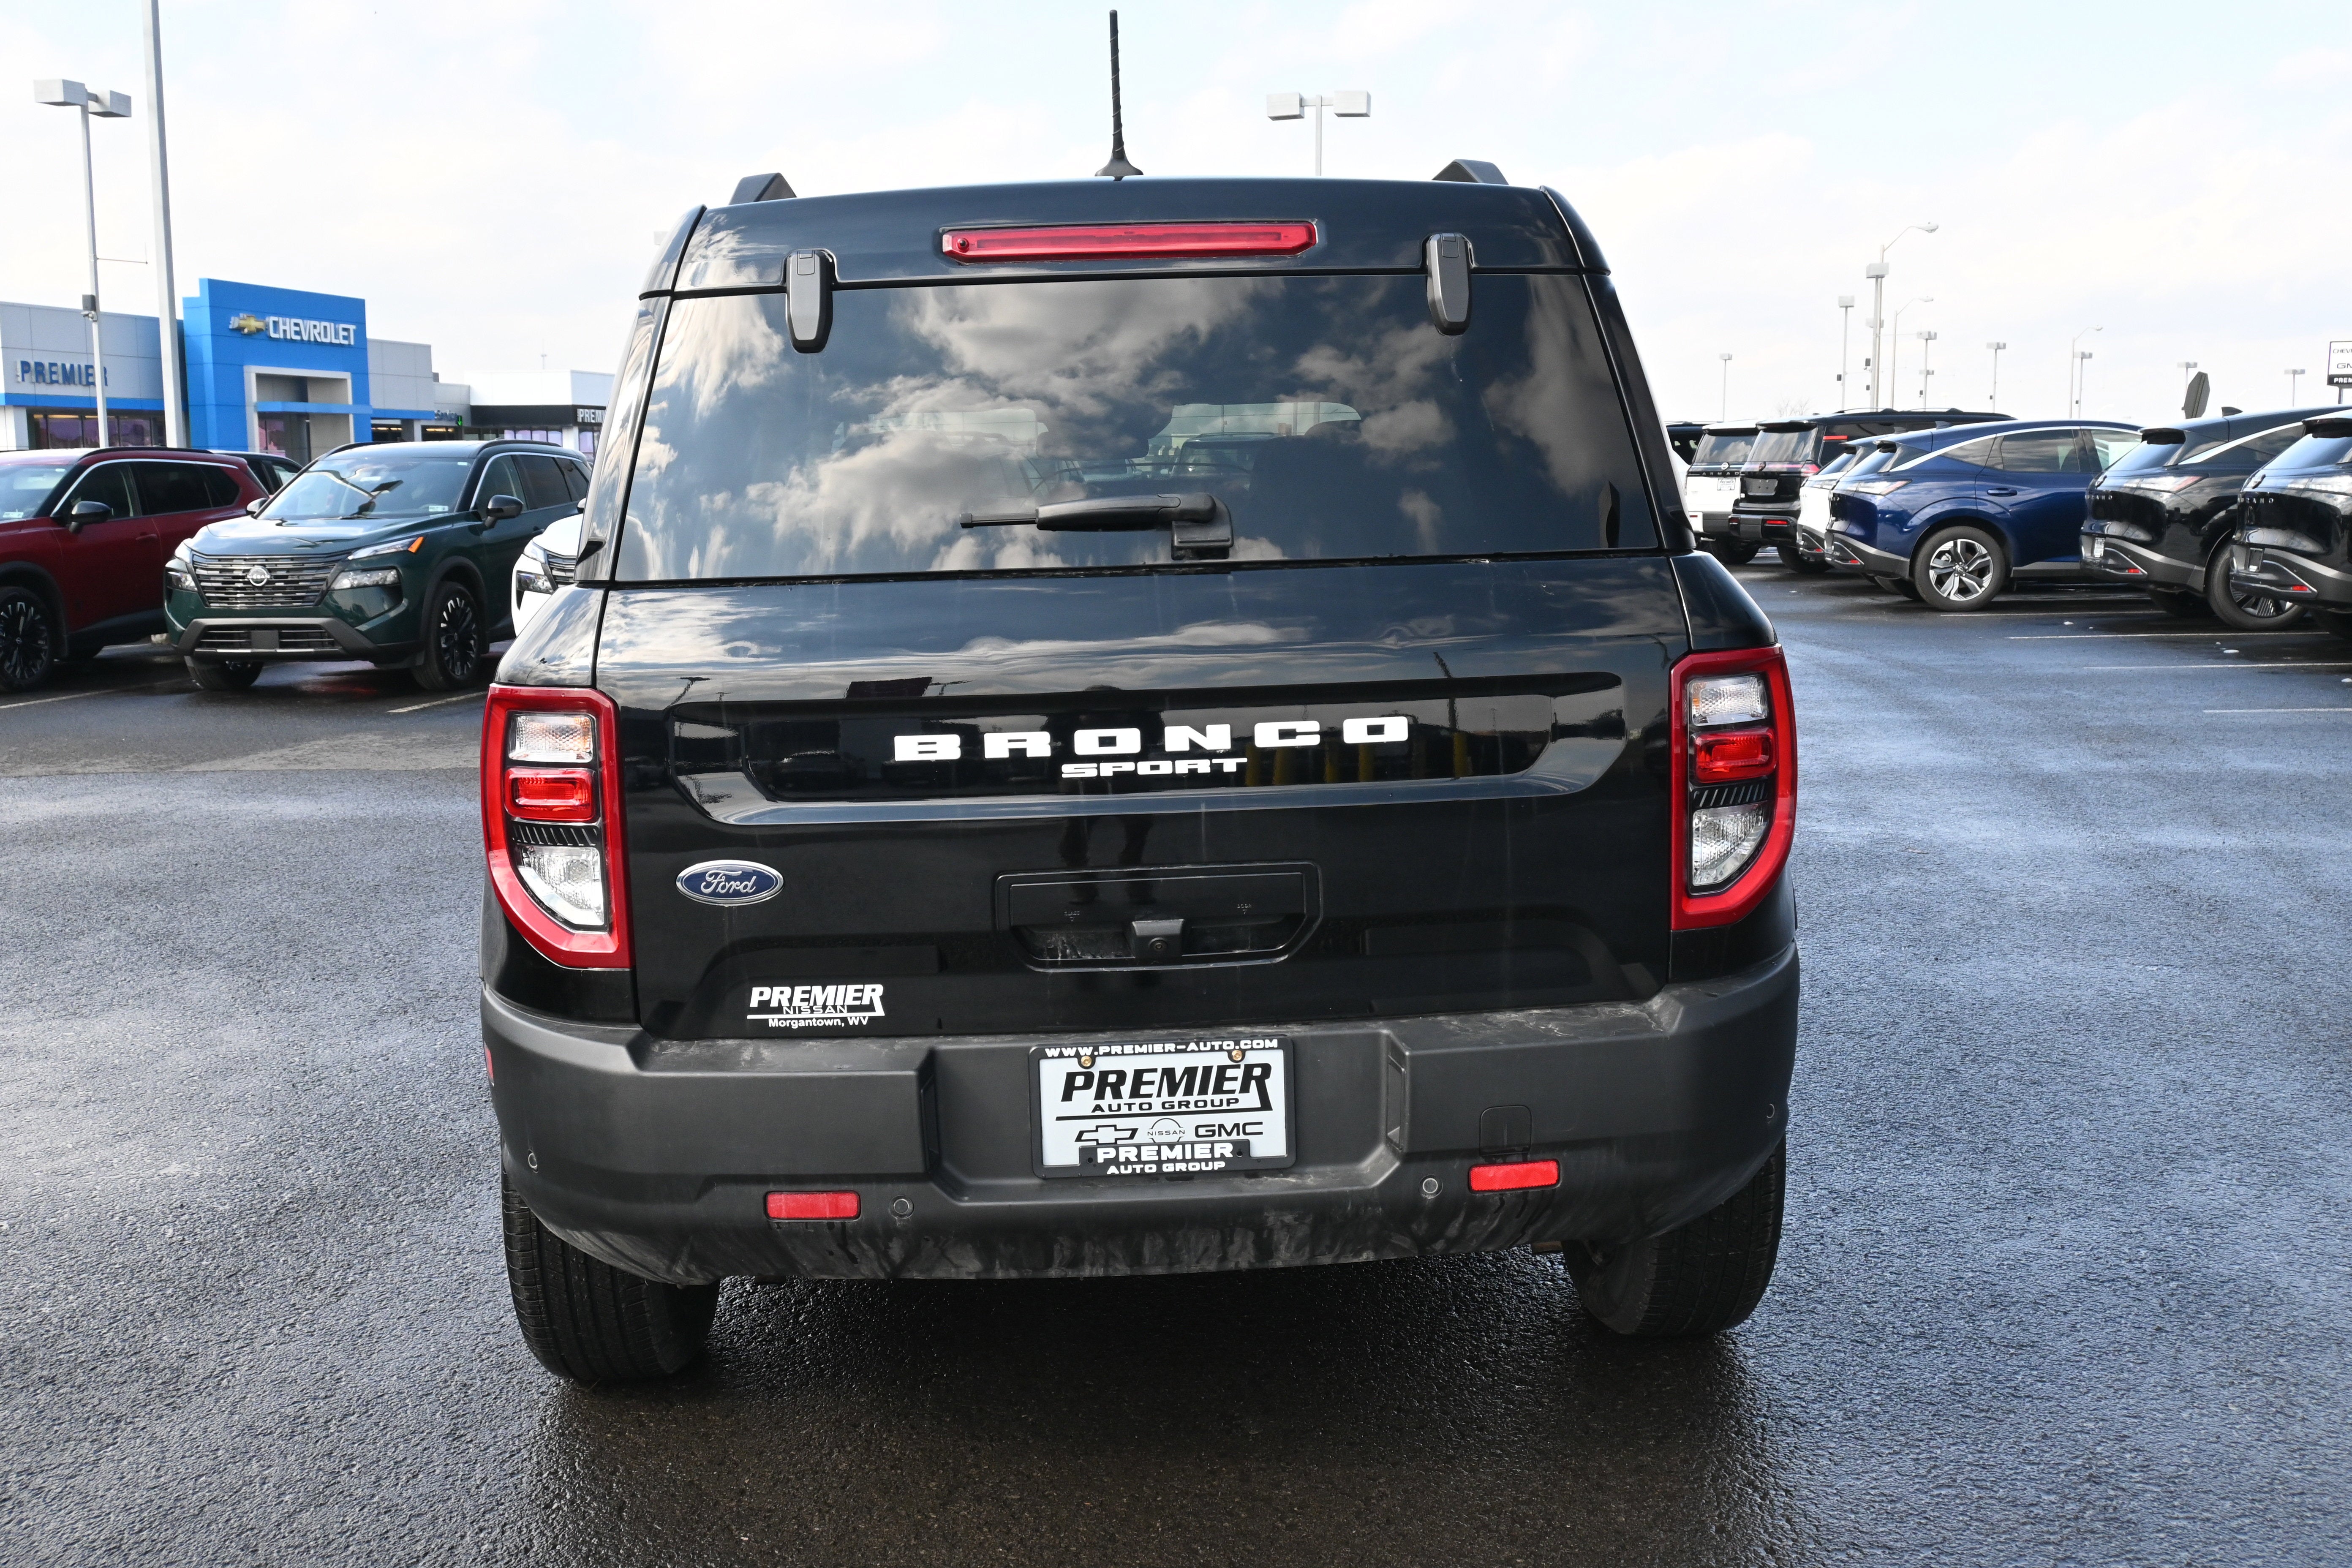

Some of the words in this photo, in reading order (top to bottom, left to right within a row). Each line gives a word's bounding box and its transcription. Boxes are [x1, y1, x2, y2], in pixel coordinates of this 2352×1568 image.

[269, 316, 356, 345] CHEVROLET
[894, 717, 1408, 761] BRONCO
[1062, 758, 1247, 778] SPORT
[700, 870, 757, 894] Ford
[749, 984, 883, 1007] PREMIER
[783, 1005, 847, 1014] NISSAN
[768, 1018, 844, 1029] Morgantown,
[847, 1016, 868, 1025] WV
[1045, 1039, 1278, 1057] WWW.PREMIER-AUTO.COM
[1061, 1063, 1272, 1102] PREMIER
[1091, 1102, 1152, 1113] AUTO
[1161, 1098, 1239, 1110] GROUP
[1195, 1122, 1263, 1138] GMC
[1097, 1142, 1233, 1163] PREMIER
[1106, 1164, 1157, 1175] AUTO
[1162, 1161, 1226, 1173] GROUP
